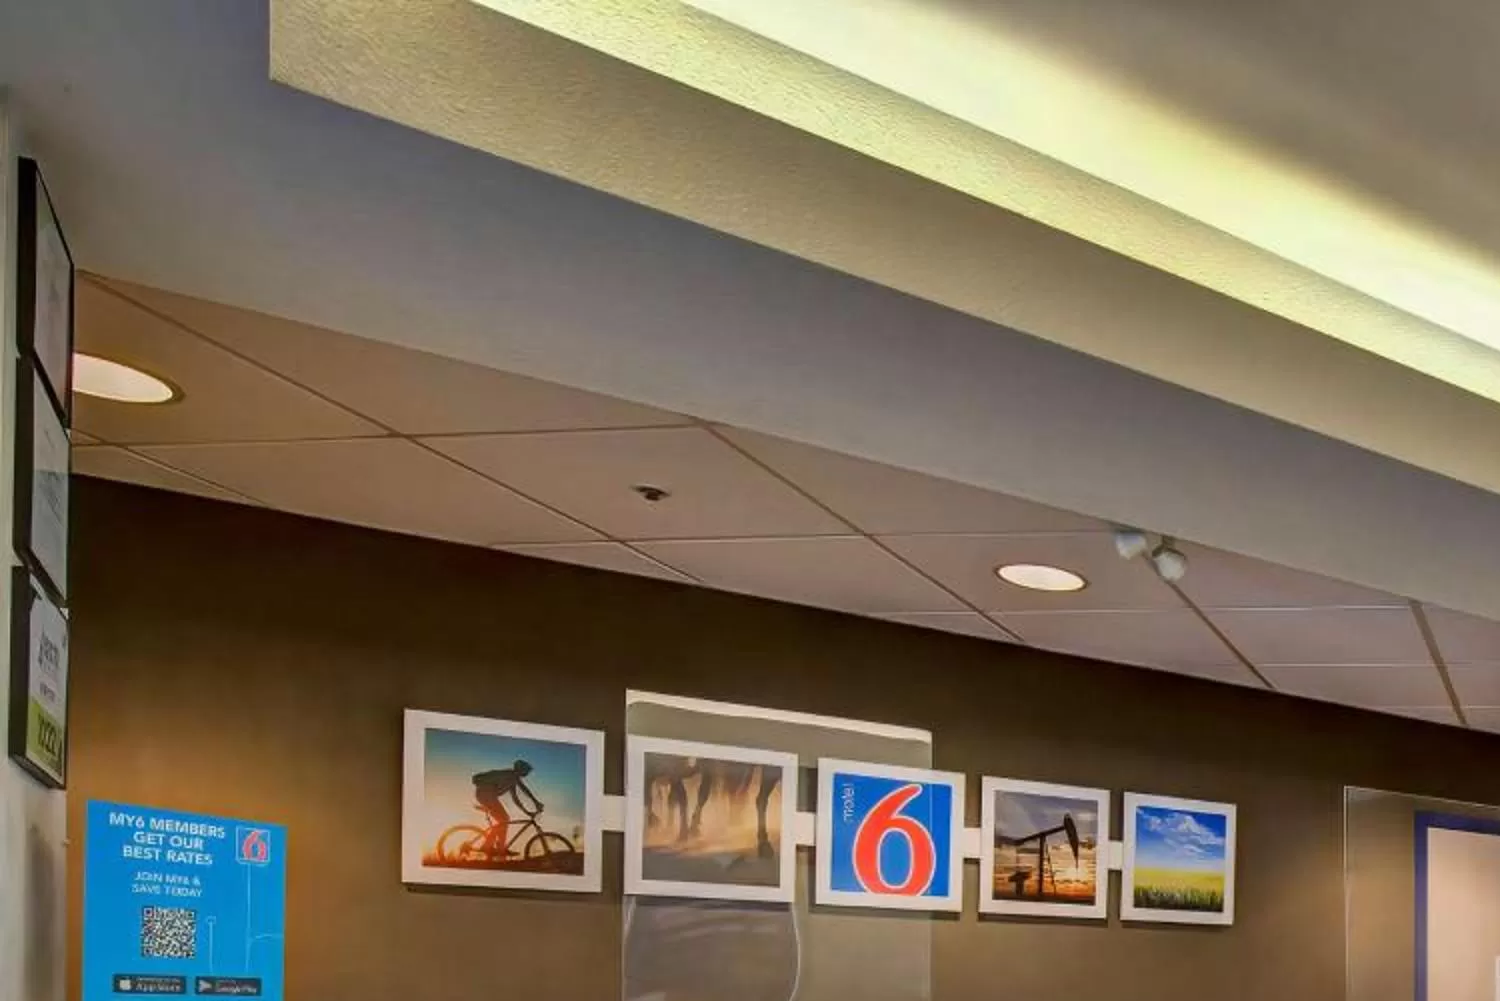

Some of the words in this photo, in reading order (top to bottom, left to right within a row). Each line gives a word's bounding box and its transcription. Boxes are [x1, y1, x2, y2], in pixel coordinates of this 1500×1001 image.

[109, 812, 145, 829] MY6
[150, 817, 226, 839] MEMBERS
[133, 831, 165, 845] GET
[169, 834, 204, 850] OUR
[852, 783, 937, 896] 6
[122, 845, 162, 861] BEST
[167, 849, 213, 865] RATES
[134, 871, 162, 882] JOIN
[132, 883, 160, 895] SAVE
[165, 886, 202, 897] TODAY
